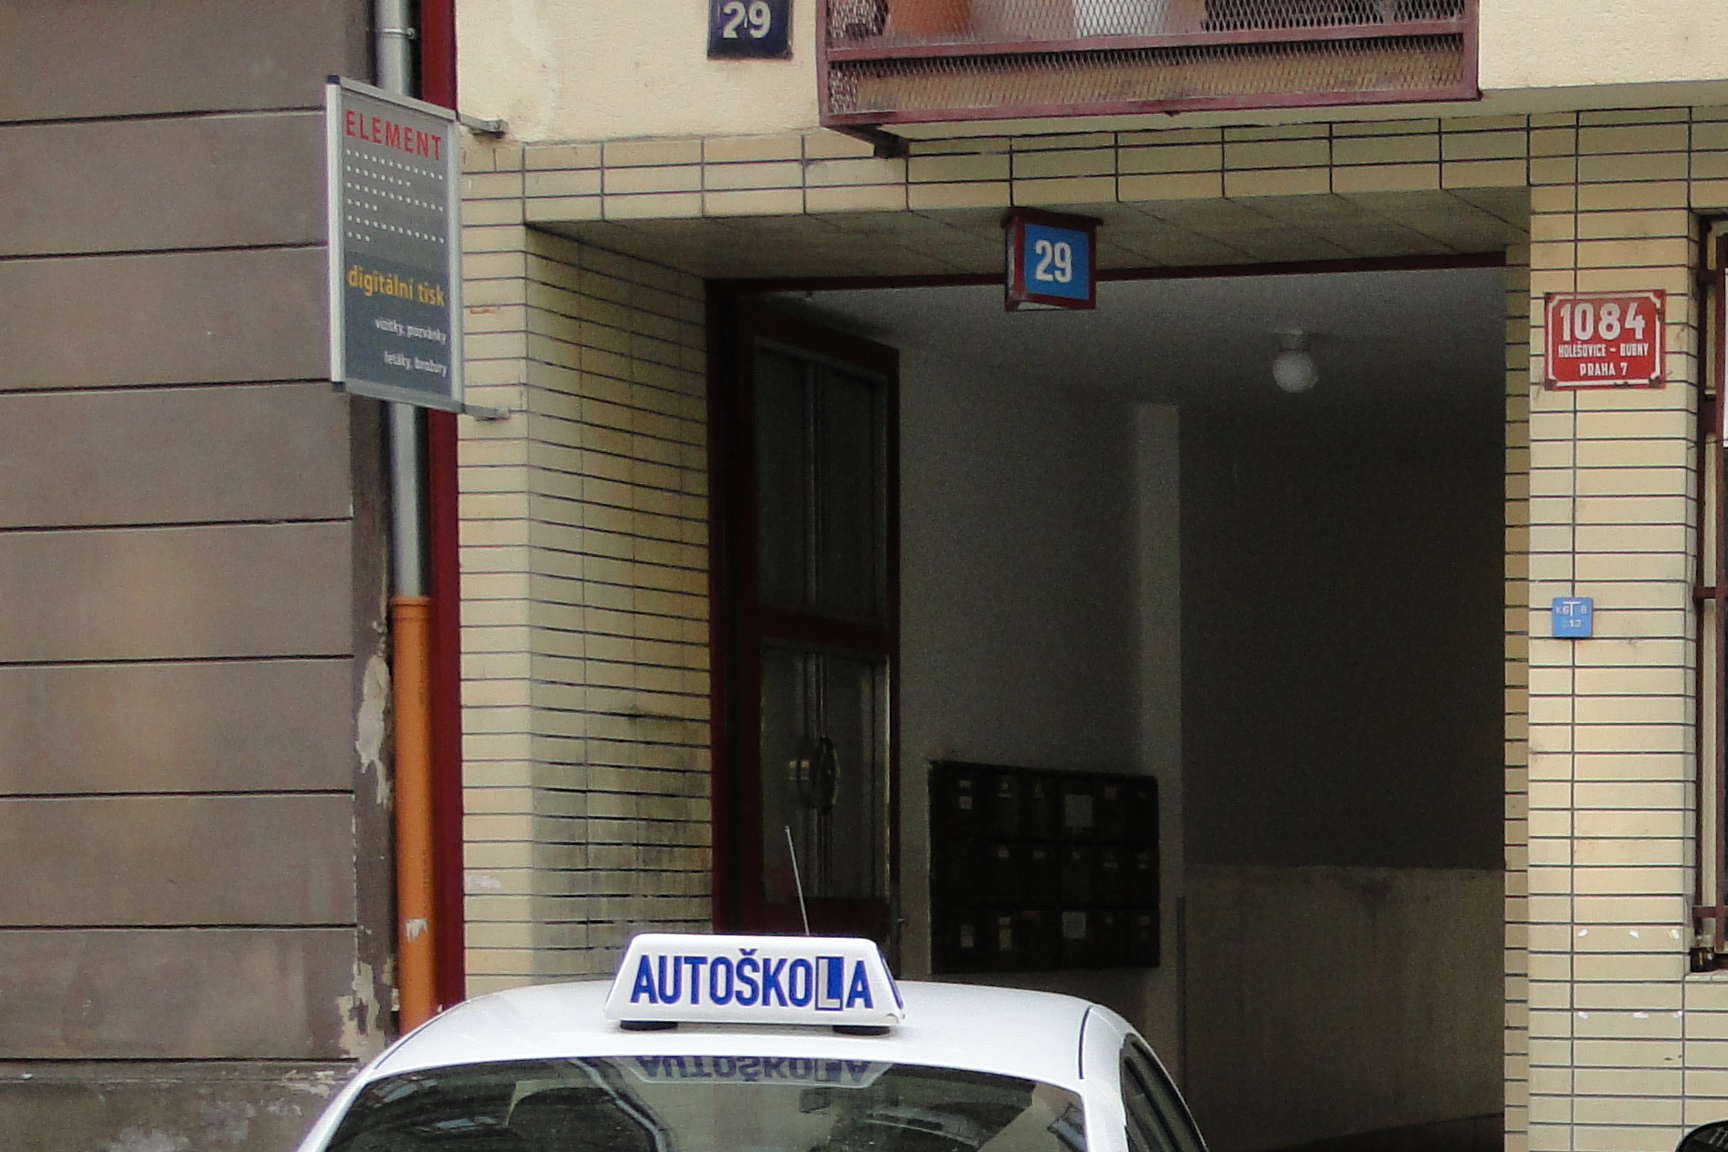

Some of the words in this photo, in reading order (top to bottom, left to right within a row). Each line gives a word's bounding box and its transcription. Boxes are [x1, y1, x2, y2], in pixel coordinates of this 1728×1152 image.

[722, 0, 771, 39] 29
[345, 108, 442, 161] ELEMENT
[1034, 239, 1072, 283] 29
[347, 264, 413, 299] digitální
[417, 282, 445, 306] tisk
[1560, 302, 1645, 341] 1084
[1558, 341, 1606, 358] HOLEŠOVICE
[1620, 343, 1649, 357] BUBNY
[1580, 362, 1616, 376] PRAHA
[1620, 362, 1628, 376] 7
[630, 949, 874, 1011] AUTOŠKOLA
